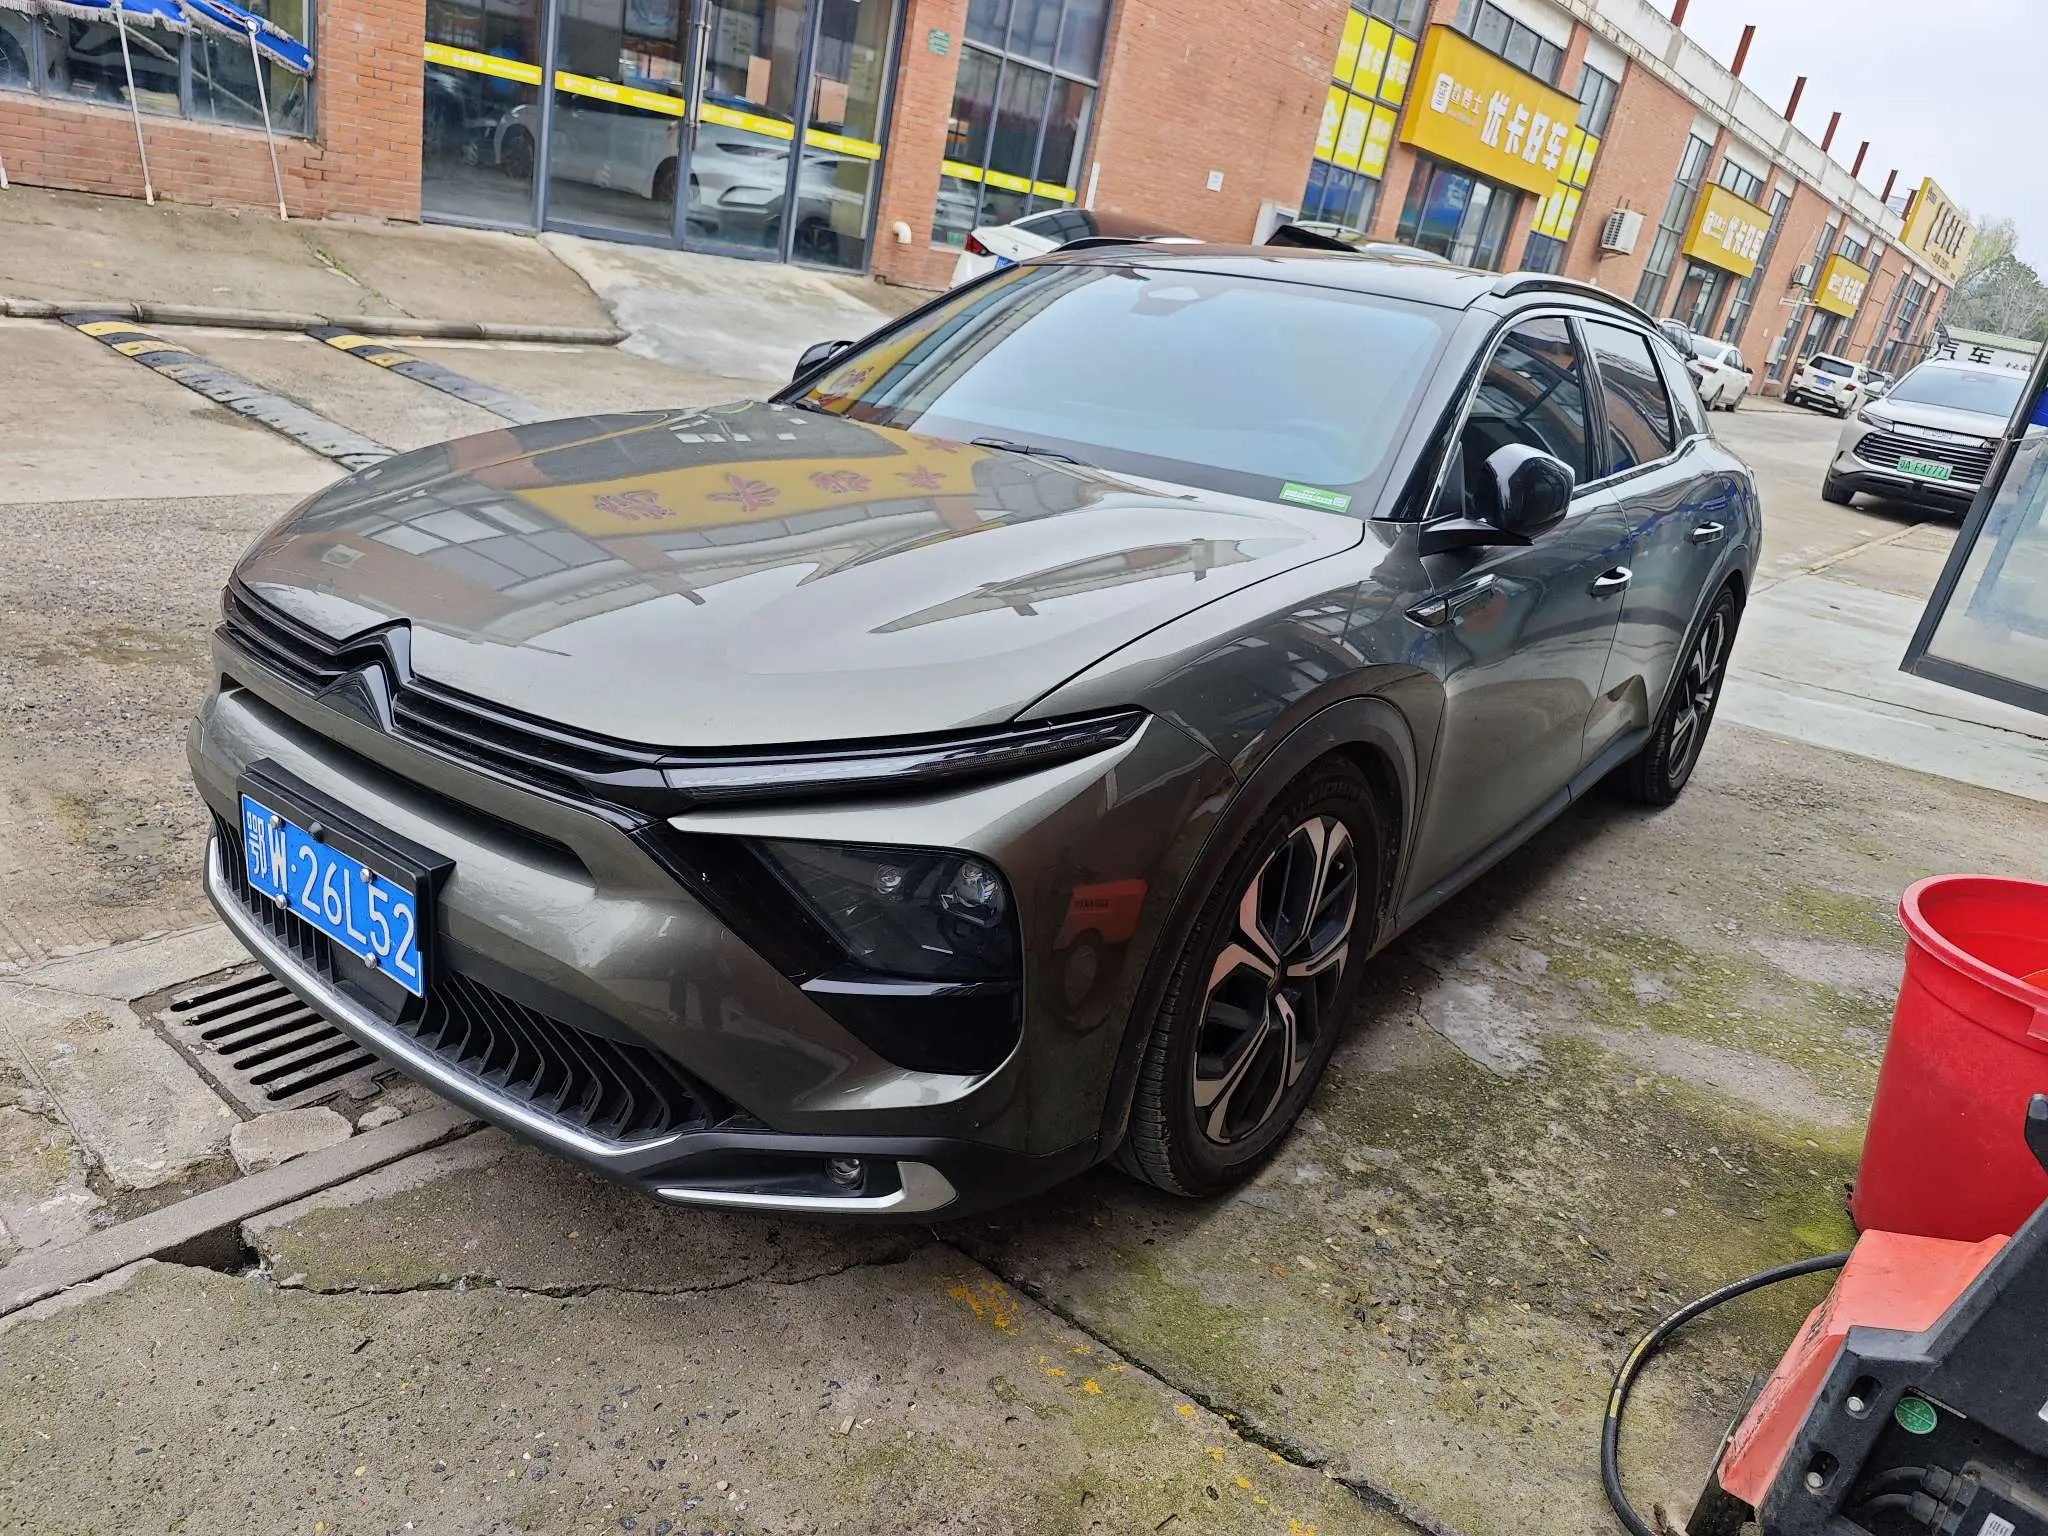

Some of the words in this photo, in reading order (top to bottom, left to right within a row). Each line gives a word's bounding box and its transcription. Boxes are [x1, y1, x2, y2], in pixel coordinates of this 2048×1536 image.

[1480, 90, 1568, 172] 优卡好车
[246, 811, 417, 978] 鄂W·26L52
